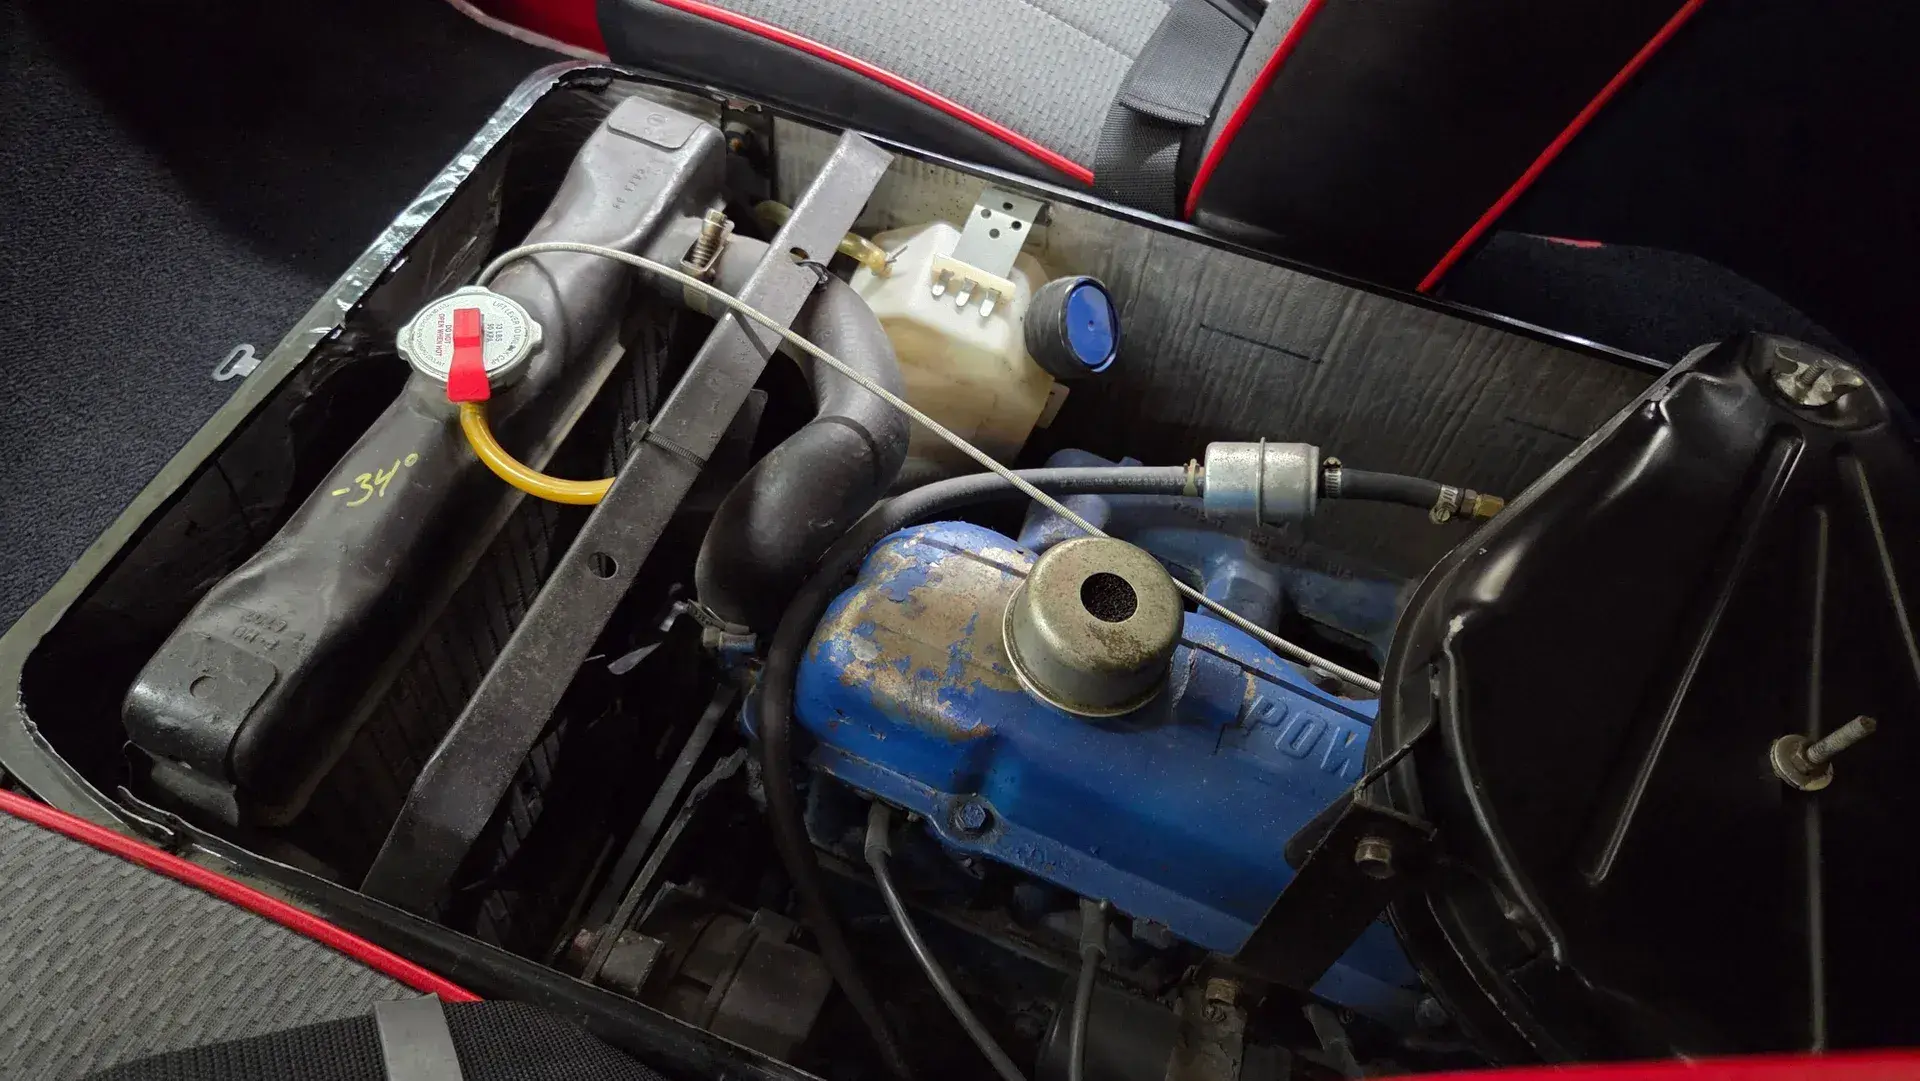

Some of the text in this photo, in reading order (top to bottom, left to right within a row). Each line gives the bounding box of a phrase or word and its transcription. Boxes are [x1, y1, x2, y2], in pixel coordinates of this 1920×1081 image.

[492, 300, 507, 310] LIFT
[505, 309, 520, 325] LEVER
[513, 326, 521, 335] TO
[435, 313, 446, 356] OPEN WHEN HOT
[444, 324, 452, 344] DO NOT
[495, 330, 503, 342] LBS
